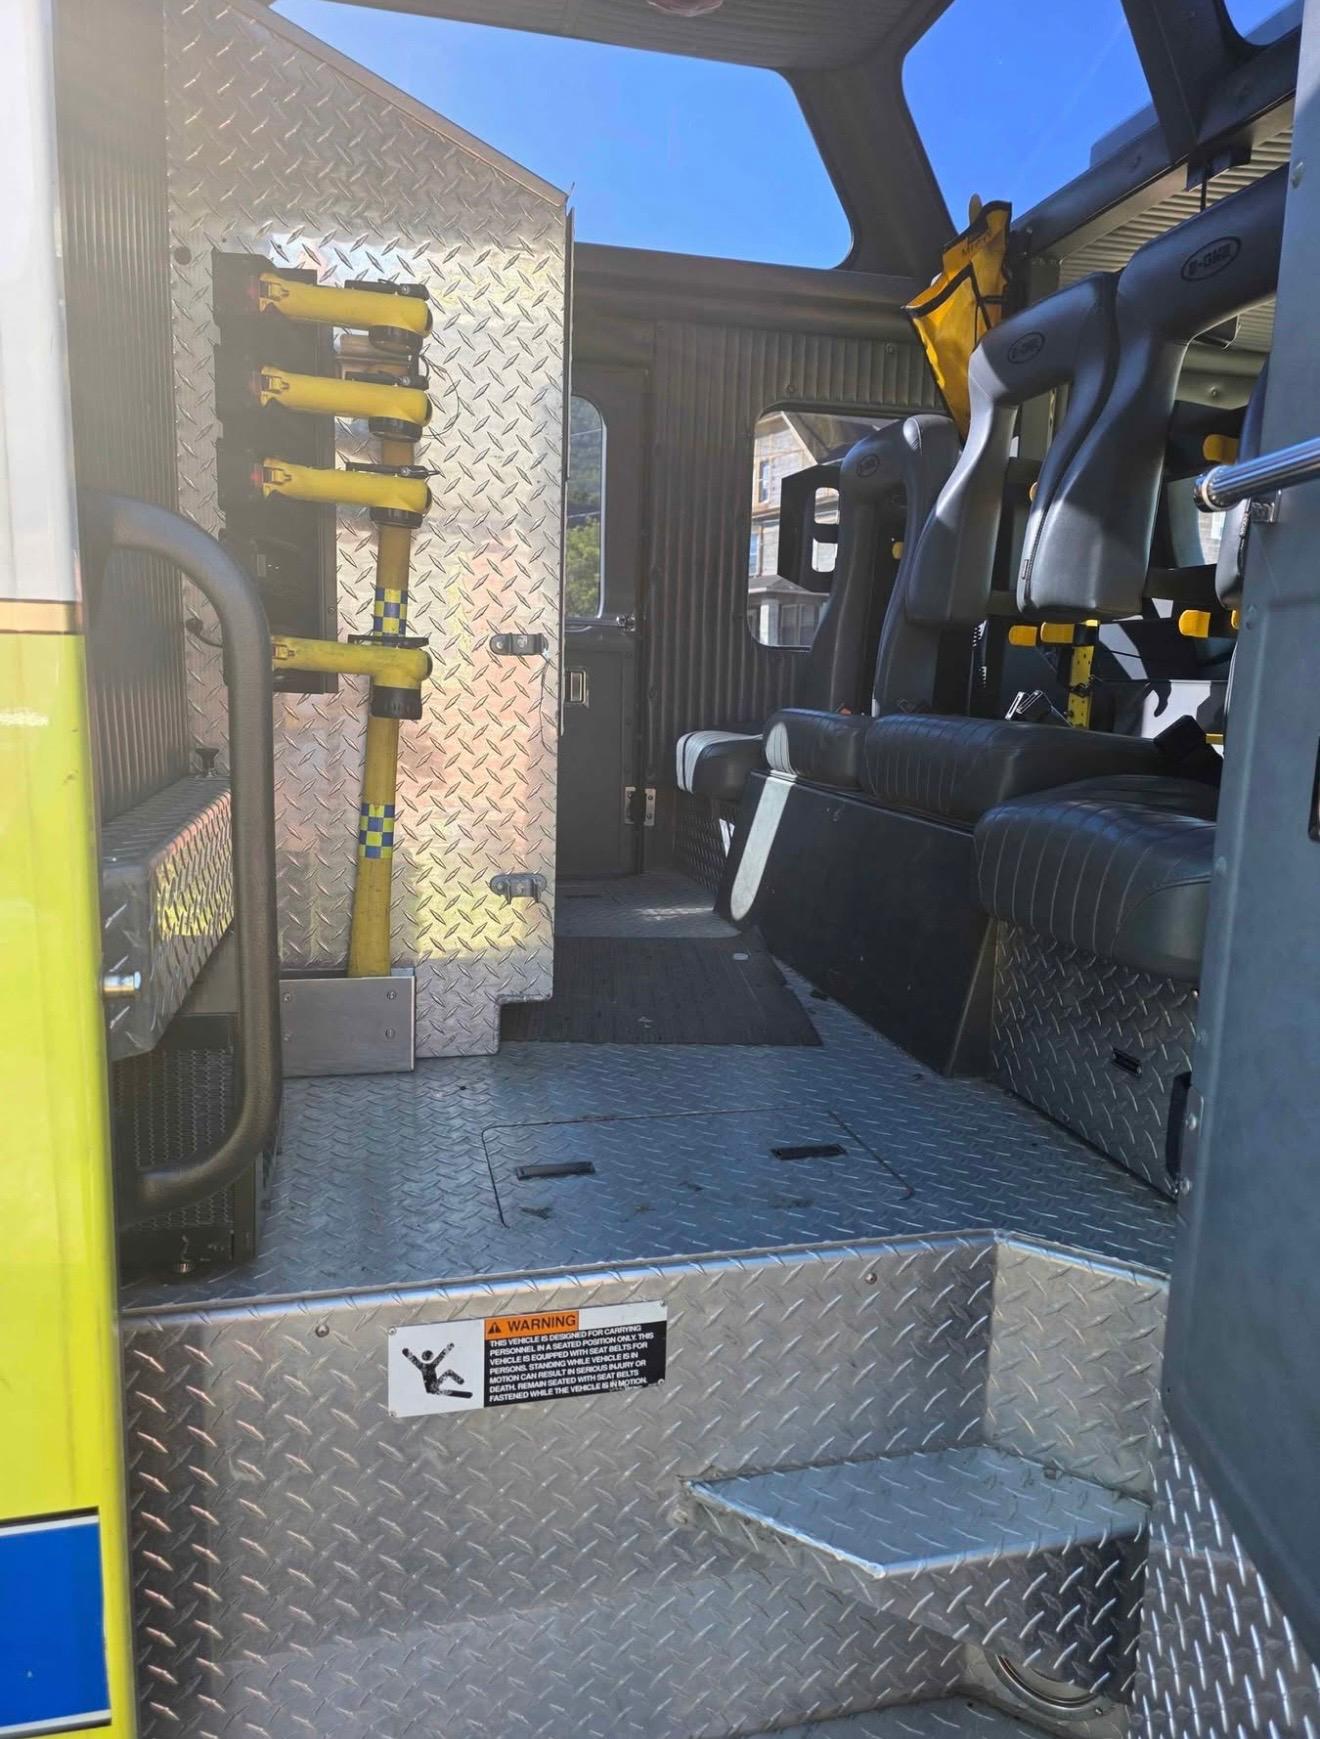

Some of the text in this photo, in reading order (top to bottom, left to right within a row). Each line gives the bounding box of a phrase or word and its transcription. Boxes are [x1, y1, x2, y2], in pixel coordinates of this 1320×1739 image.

[508, 1315, 576, 1332] WARNING
[490, 1346, 536, 1356] PERSONNEL
[553, 1340, 581, 1349] SEATED
[583, 1337, 616, 1346] POSITION
[639, 1332, 654, 1340] THIS
[508, 1336, 540, 1345] VEHICLE
[549, 1330, 587, 1340] DESIGNED
[604, 1325, 642, 1335] CARRYING
[490, 1356, 522, 1366] VEHICLE
[531, 1351, 569, 1361] EQUIPPED
[570, 1348, 589, 1356] WITH
[589, 1346, 608, 1354] SEAT
[609, 1343, 632, 1352] BELTS
[633, 1341, 648, 1349] FOR
[529, 1360, 566, 1371] STANDING
[567, 1357, 590, 1366] WHILE
[591, 1353, 622, 1363] VEHICLE
[490, 1375, 520, 1384] MOTION
[538, 1369, 566, 1378] RESULT
[576, 1365, 608, 1375] SERIOUS
[609, 1361, 634, 1370] INJURY
[635, 1359, 647, 1367] OR
[518, 1381, 547, 1390] REMAIN
[548, 1377, 576, 1386] SEATED
[597, 1372, 615, 1380] SEAT
[617, 1369, 639, 1378] BELTS
[490, 1392, 529, 1402] FASTENED
[530, 1389, 554, 1397] WHILE
[555, 1386, 569, 1394] THE
[570, 1383, 601, 1393] VEHICLE
